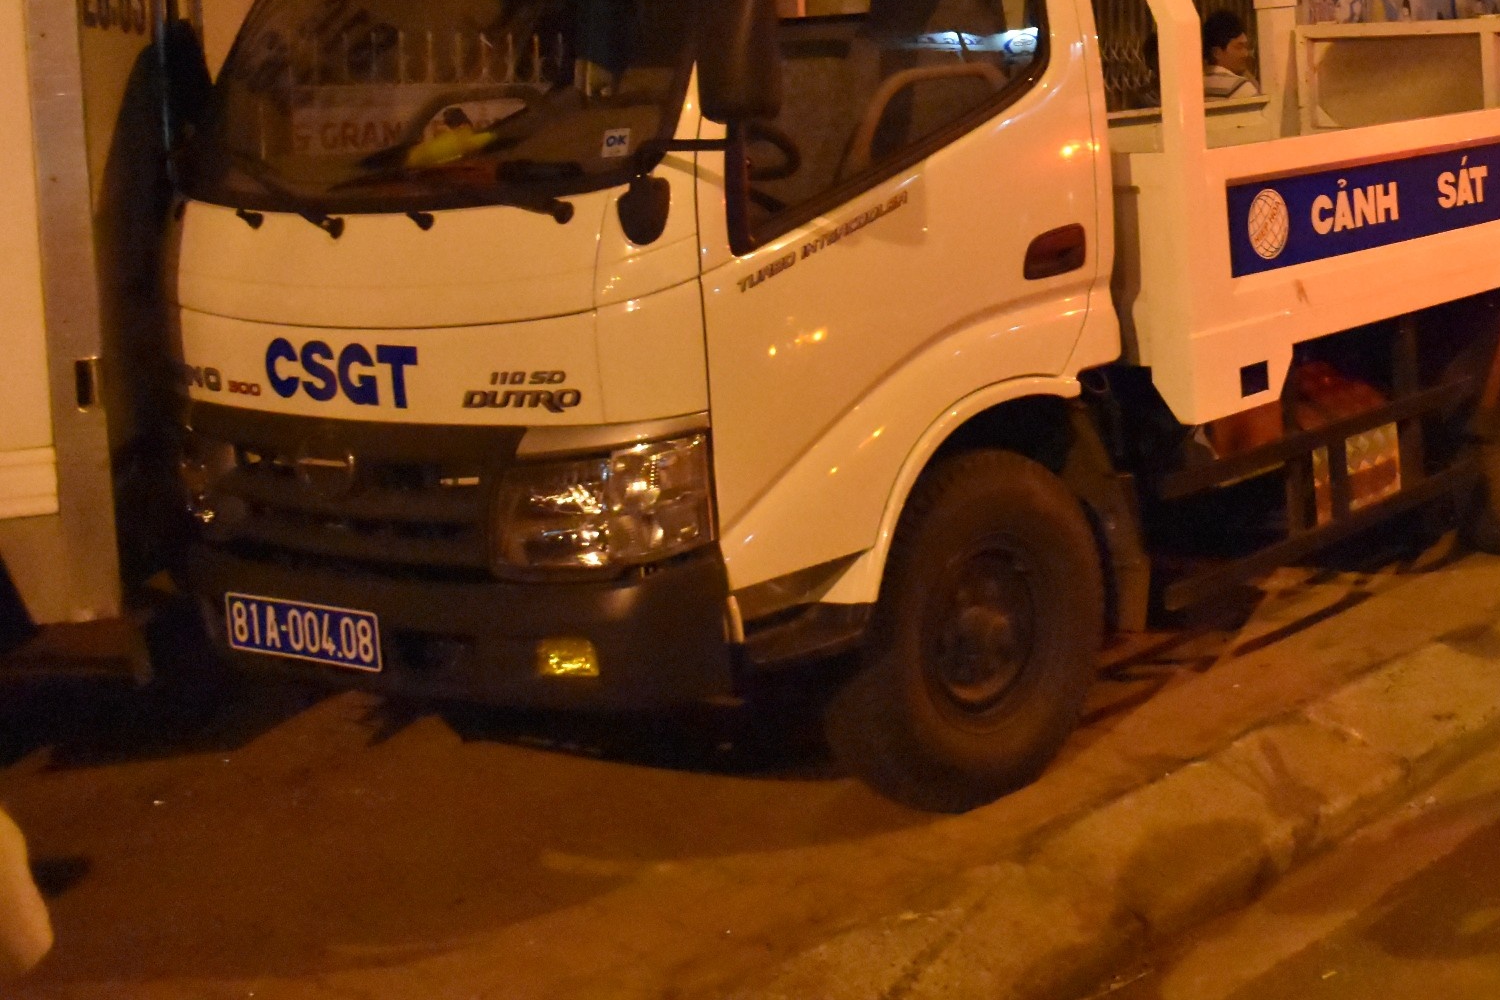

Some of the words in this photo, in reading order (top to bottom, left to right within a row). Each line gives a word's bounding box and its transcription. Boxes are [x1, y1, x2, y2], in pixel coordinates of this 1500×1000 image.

[606, 134, 628, 148] OK
[1310, 178, 1400, 235] CẢNH
[1437, 155, 1489, 210] SÁT
[737, 252, 797, 293] TURBO
[266, 337, 418, 409] CSGT
[489, 371, 527, 386] 110
[528, 370, 567, 385] SD
[462, 388, 582, 413] DUTRO
[231, 600, 375, 664] 81A-004.08
